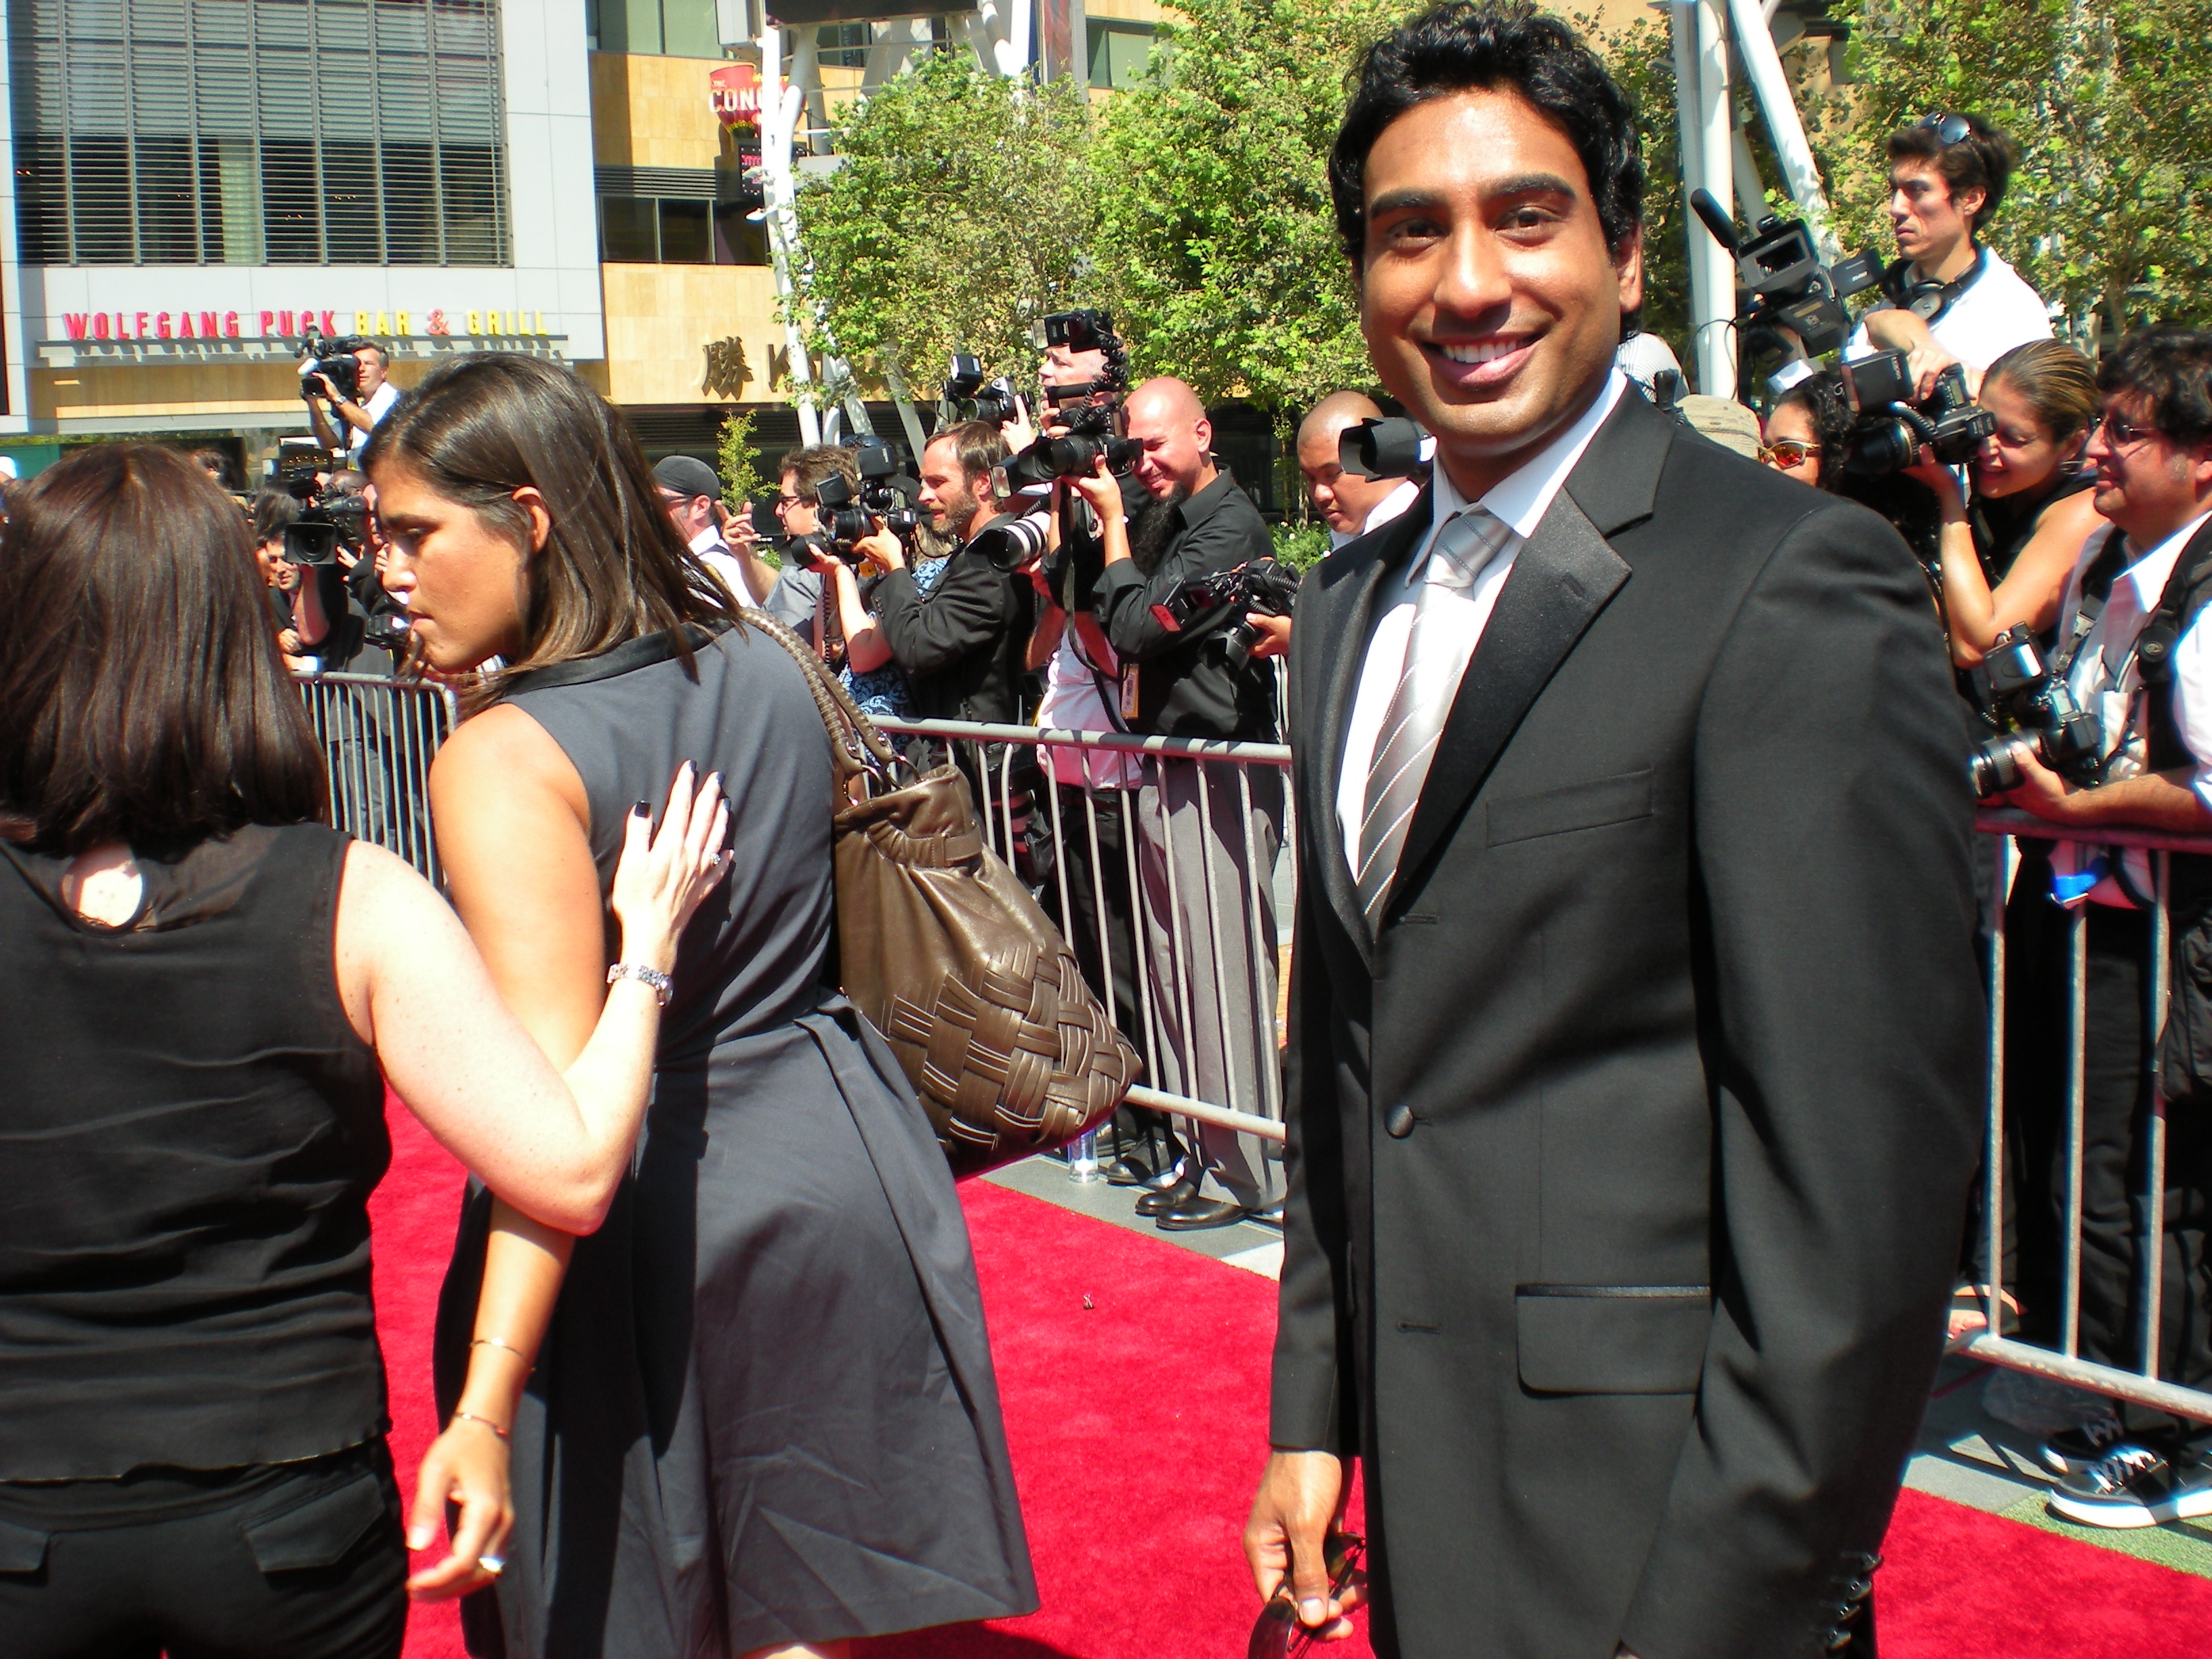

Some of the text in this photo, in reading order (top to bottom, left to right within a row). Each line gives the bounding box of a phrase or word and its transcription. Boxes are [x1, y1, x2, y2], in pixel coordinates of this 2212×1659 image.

[63, 309, 548, 340] WOLFGANG PUCK BAR & GRILL
[701, 335, 754, 401] 勝
